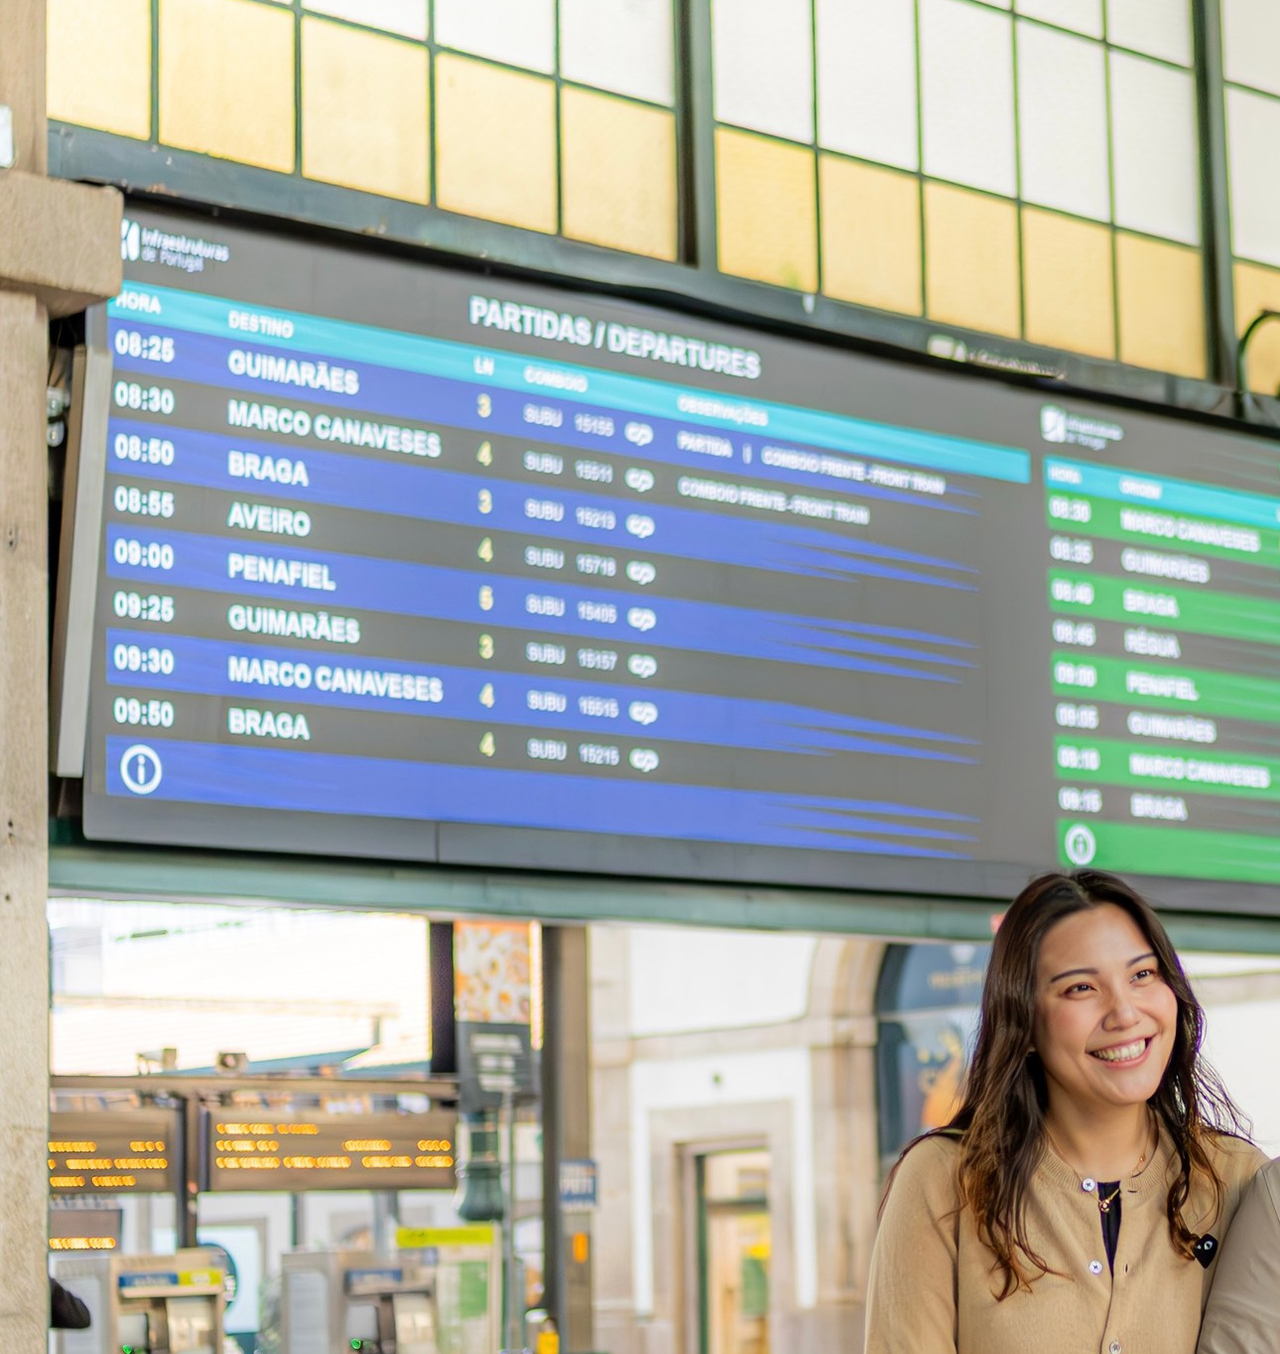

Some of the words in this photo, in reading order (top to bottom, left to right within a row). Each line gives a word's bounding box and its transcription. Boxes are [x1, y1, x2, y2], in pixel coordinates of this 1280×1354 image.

[116, 290, 162, 315] HORA
[228, 310, 294, 339] DESTINO
[469, 295, 593, 348] PARTIDAS
[608, 328, 761, 380] DEPARTURES
[115, 329, 174, 363] 08:25
[228, 349, 360, 396] GUIMARÃES
[115, 381, 174, 415] 08:30
[228, 399, 311, 437] MARCO
[314, 413, 441, 458] CANAVESES
[114, 433, 174, 467] 08:50
[228, 451, 309, 488] BRAGA
[114, 486, 174, 519] 08:55
[228, 502, 311, 537] AVEIRO
[114, 538, 174, 571] 09:00
[228, 553, 336, 591] PENAFIEL
[114, 591, 174, 623] 09:25
[228, 603, 360, 645] GUIMARÃES
[114, 644, 174, 675] 09:30
[228, 656, 311, 689] MARCO
[315, 666, 444, 703] CANAVESES
[114, 697, 174, 729] 09:50
[228, 708, 310, 740] BRAGA
